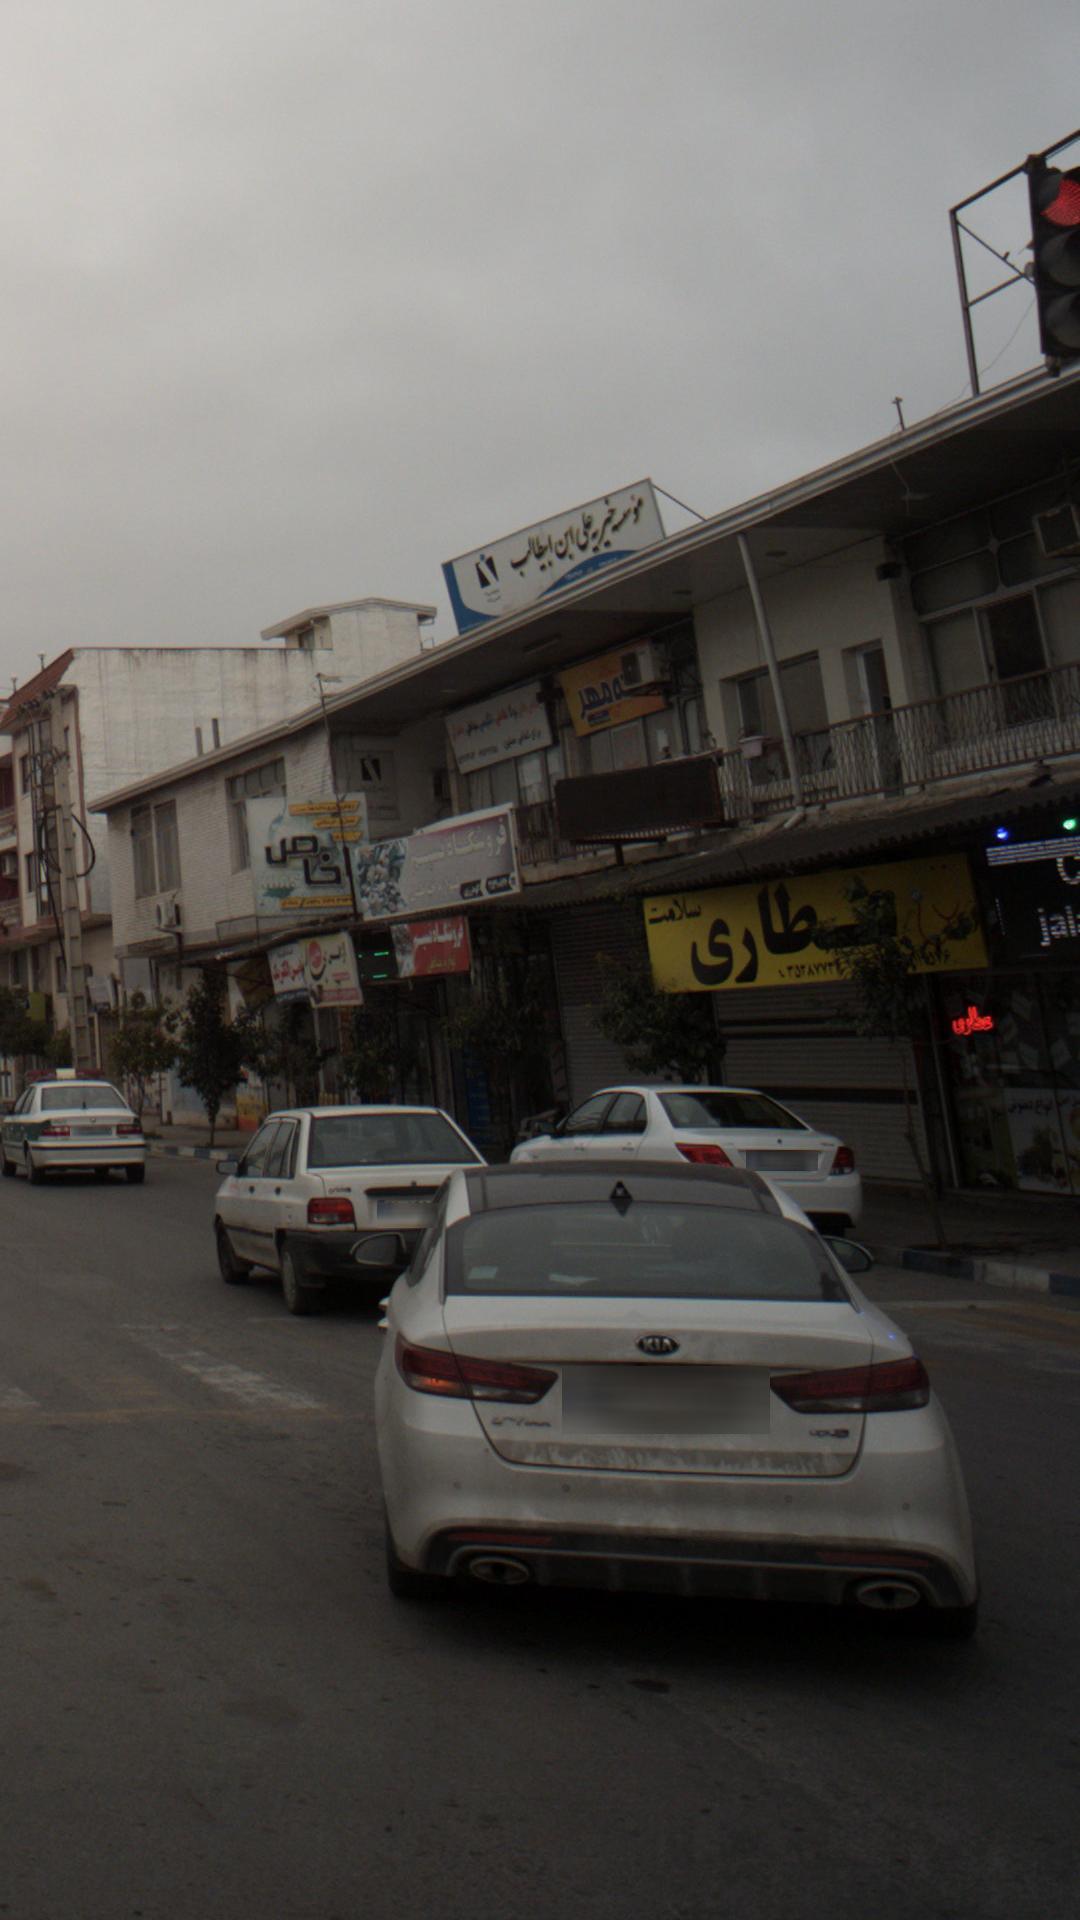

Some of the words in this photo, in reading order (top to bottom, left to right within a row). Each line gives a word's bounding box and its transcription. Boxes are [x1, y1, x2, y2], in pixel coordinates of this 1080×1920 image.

[555, 525, 575, 559] ابن
[575, 512, 593, 550] علی
[648, 896, 702, 924] سلامت
[952, 1006, 994, 1036] عطاری
[643, 1338, 672, 1352] KIA
